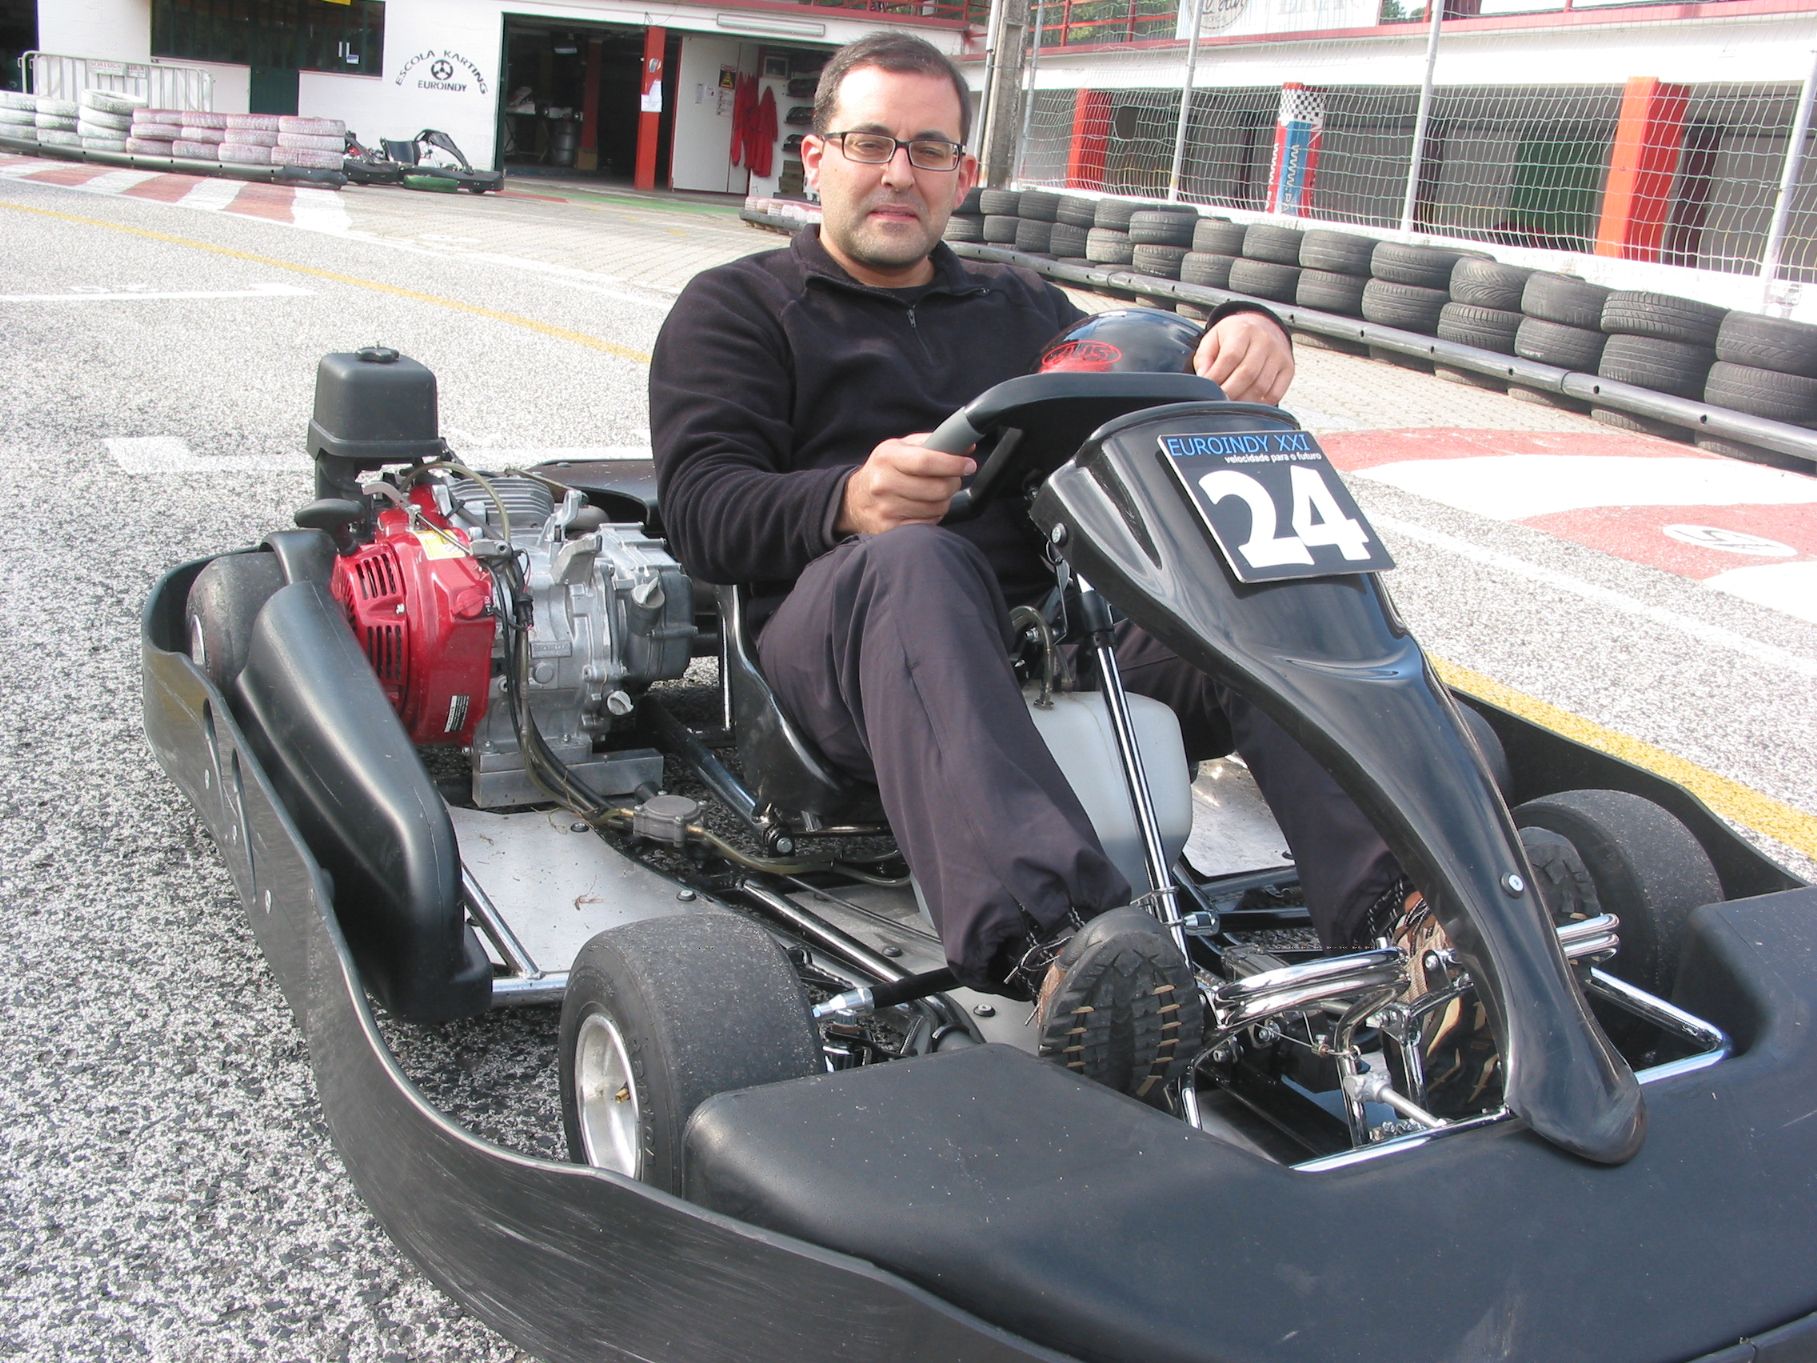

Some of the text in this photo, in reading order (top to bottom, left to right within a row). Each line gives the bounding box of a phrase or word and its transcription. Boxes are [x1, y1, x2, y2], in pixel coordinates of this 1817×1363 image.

[395, 49, 488, 95] ESCOLA KARTING
[417, 80, 467, 92] EUROINDY
[1167, 433, 1311, 457] EUROINDY XXI
[1224, 451, 1322, 463] velocidade para o futuro
[1198, 464, 1372, 568] 24
